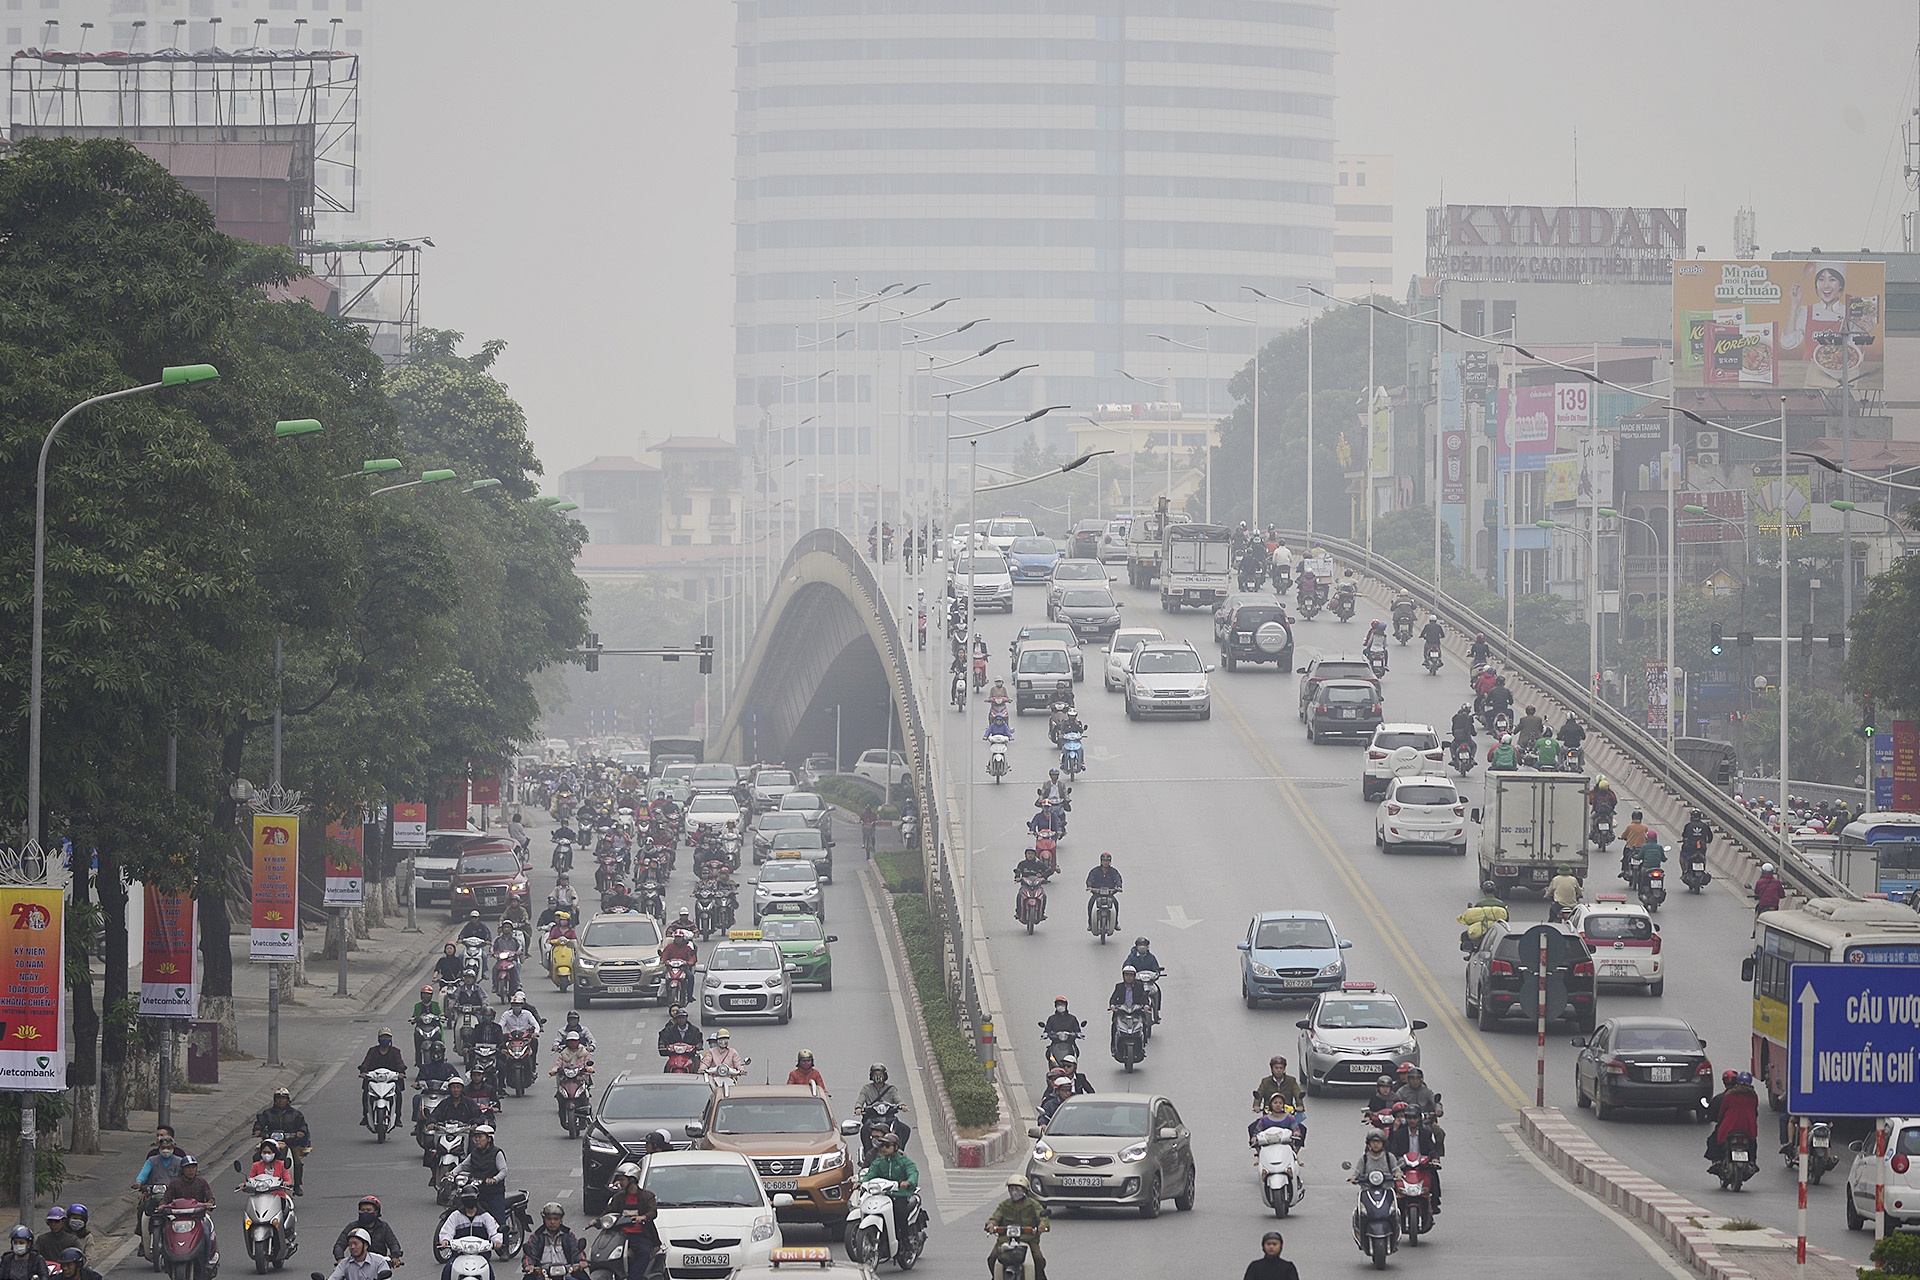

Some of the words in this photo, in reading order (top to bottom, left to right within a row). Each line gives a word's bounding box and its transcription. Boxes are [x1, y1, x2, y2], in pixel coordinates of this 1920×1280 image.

[1447, 204, 1687, 249] KYMDAN
[1487, 256, 1525, 275] 100%
[1529, 257, 1561, 274] CAO
[1639, 255, 1674, 276] NHIÊ
[1724, 267, 1740, 278] Mì
[1743, 266, 1764, 278] nấu
[1717, 286, 1735, 296] mì
[1737, 283, 1778, 296] chuẩn
[1557, 388, 1588, 411] 139
[1621, 423, 1635, 431] MADE
[1641, 423, 1661, 431] TAIWAN
[262, 826, 290, 846] 70
[10, 903, 51, 930] 70
[252, 940, 294, 948] Vietcombank
[25, 946, 46, 958] NIỆM
[15, 959, 25, 969] 70
[26, 958, 44, 969] NĂM
[19, 971, 40, 981] NGÀY
[8, 984, 28, 994] TOÀN
[29, 983, 50, 995] QUỐC
[0, 997, 27, 1007] KHÁNG
[28, 995, 51, 1007] CHIẾN
[142, 997, 191, 1005] Vietcombank
[1847, 988, 1883, 1024] CẦU
[1819, 1041, 1883, 1083] NGUYỄN
[1887, 1046, 1915, 1083] CHÍ
[774, 1250, 798, 1260] Taxi
